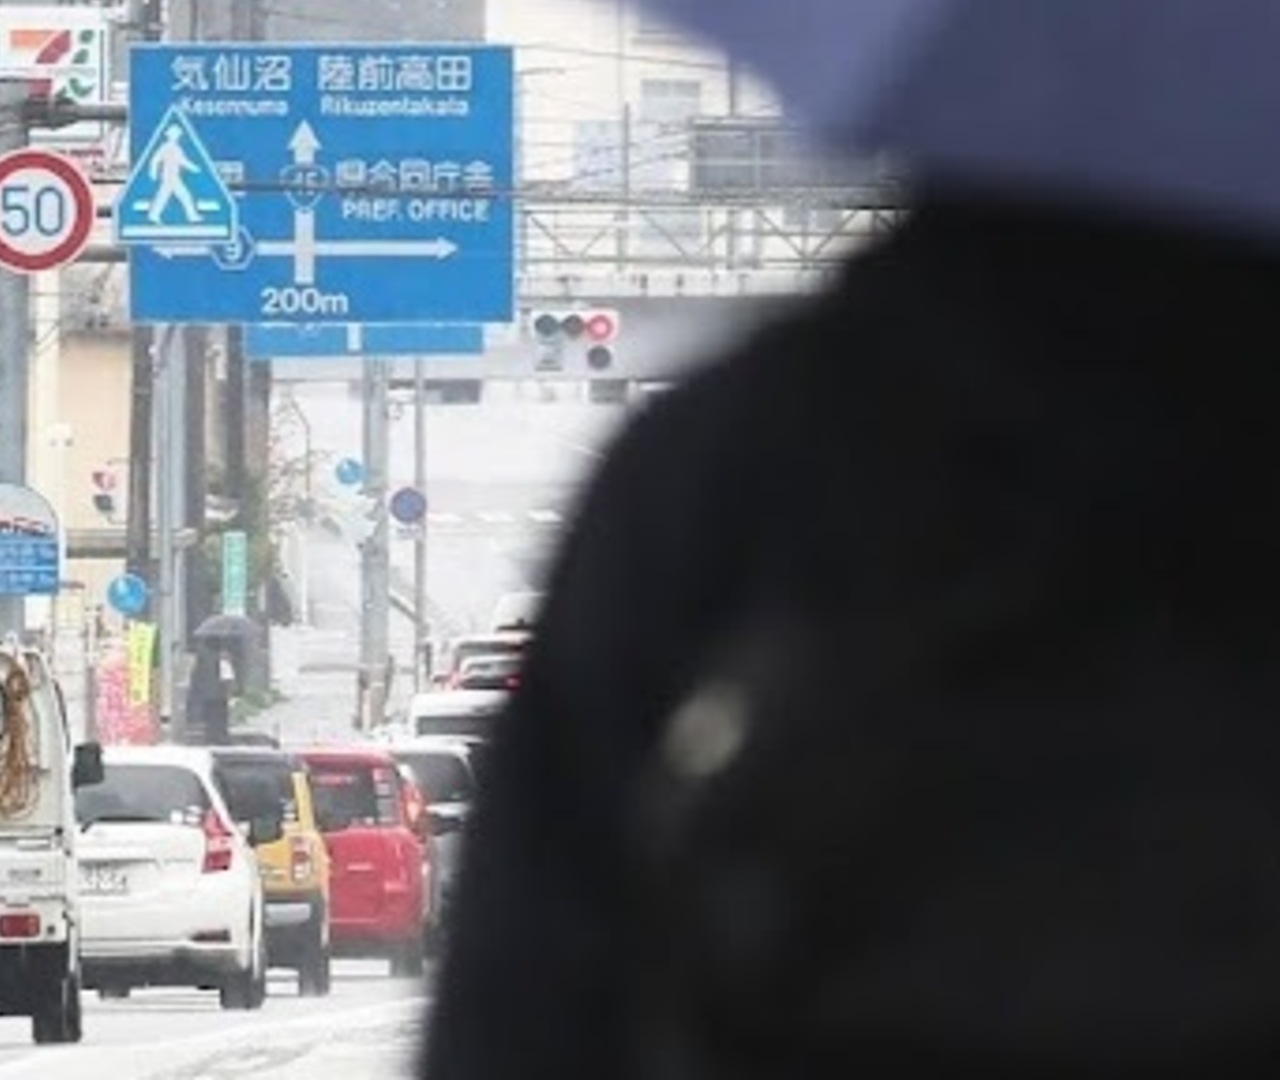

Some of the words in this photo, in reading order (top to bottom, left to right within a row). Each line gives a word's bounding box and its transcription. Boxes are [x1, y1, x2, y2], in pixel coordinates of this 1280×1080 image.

[171, 54, 292, 92] 気仙沼
[317, 54, 473, 93] 陸前高田
[1, 186, 65, 238] 50
[342, 199, 402, 221] PREF.
[408, 199, 489, 221] OFFICE
[260, 288, 349, 316] 200m
